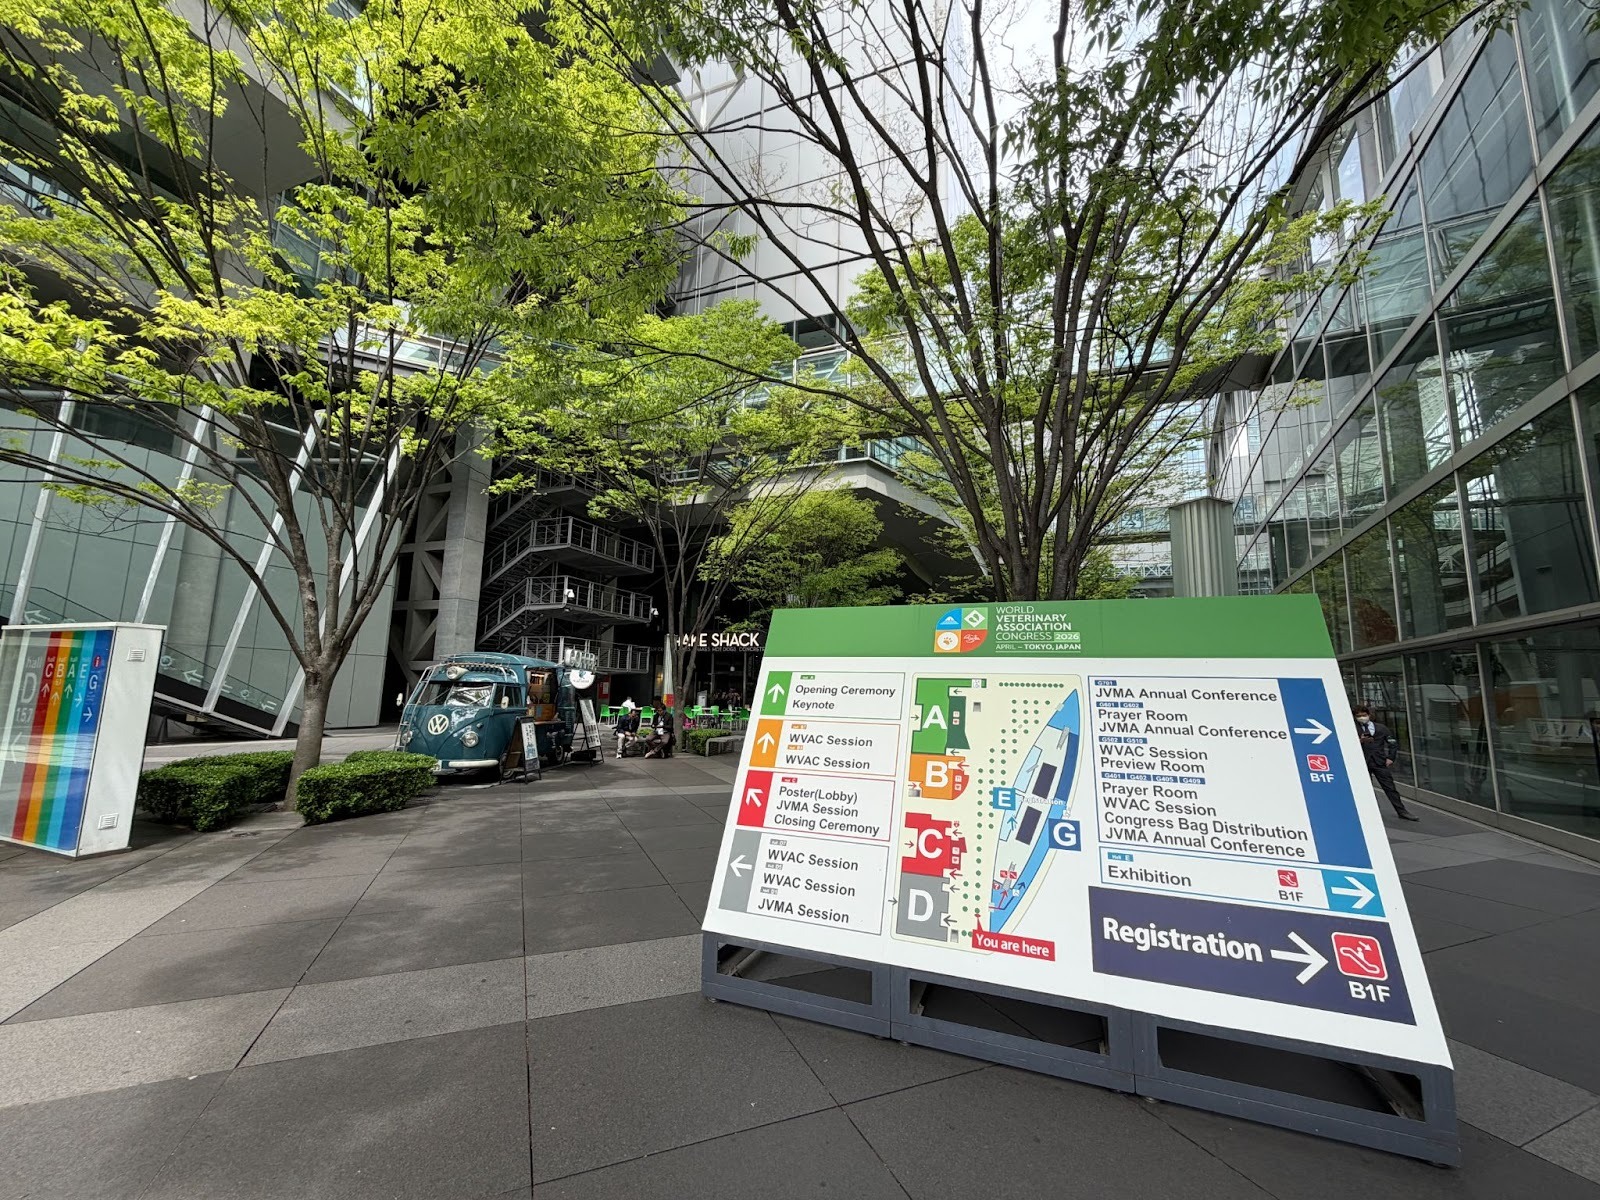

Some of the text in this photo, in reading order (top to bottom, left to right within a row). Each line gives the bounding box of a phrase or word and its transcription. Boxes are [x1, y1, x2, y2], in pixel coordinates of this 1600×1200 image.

[996, 606, 1034, 614] WORLD
[996, 614, 1067, 622] VETERINARY
[996, 622, 1071, 631] ASSOCIATION
[711, 633, 759, 646] SHACK
[996, 632, 1052, 641] CONGRESS
[46, 663, 54, 678] C
[57, 663, 64, 678] B
[67, 663, 75, 678] A
[80, 664, 88, 678] E
[21, 672, 37, 703] D
[89, 674, 98, 690] G
[796, 685, 896, 697] Opening Ceremony
[1096, 688, 1277, 701] JVMA Annual Conference
[793, 700, 834, 710] Keynote
[922, 705, 947, 729] A
[1098, 709, 1188, 722] Prayer Room
[1099, 722, 1287, 740] JVMA Annual Conference
[789, 734, 873, 747] WVAC Session
[1100, 745, 1208, 760] WVAC Session
[785, 755, 870, 769] WVAC Session
[1101, 757, 1205, 773] Preview Room
[926, 761, 948, 788] B
[1310, 773, 1334, 783] B1F
[779, 786, 857, 804] Poster(Lobby)
[998, 791, 1011, 806] E
[1102, 782, 1198, 799] Prayer Room
[777, 800, 858, 817] JVMA Session
[1103, 797, 1216, 816] WVAC Session
[774, 814, 880, 837] Closing Ceremony
[1104, 812, 1308, 840] Congress Bag Distribution
[1053, 822, 1077, 846] G
[918, 828, 943, 858] C
[1105, 828, 1305, 857] JVMA Annual Conference
[768, 849, 859, 871] WVAC Session
[1108, 865, 1192, 887] Exhibition
[763, 873, 856, 897] WVAC Session
[1278, 890, 1303, 902] B1F
[758, 898, 849, 923] JVMA Session
[907, 889, 934, 922] D
[976, 934, 1049, 957] You are here
[1102, 917, 1263, 962] Registration
[1348, 981, 1391, 1002] B1F
